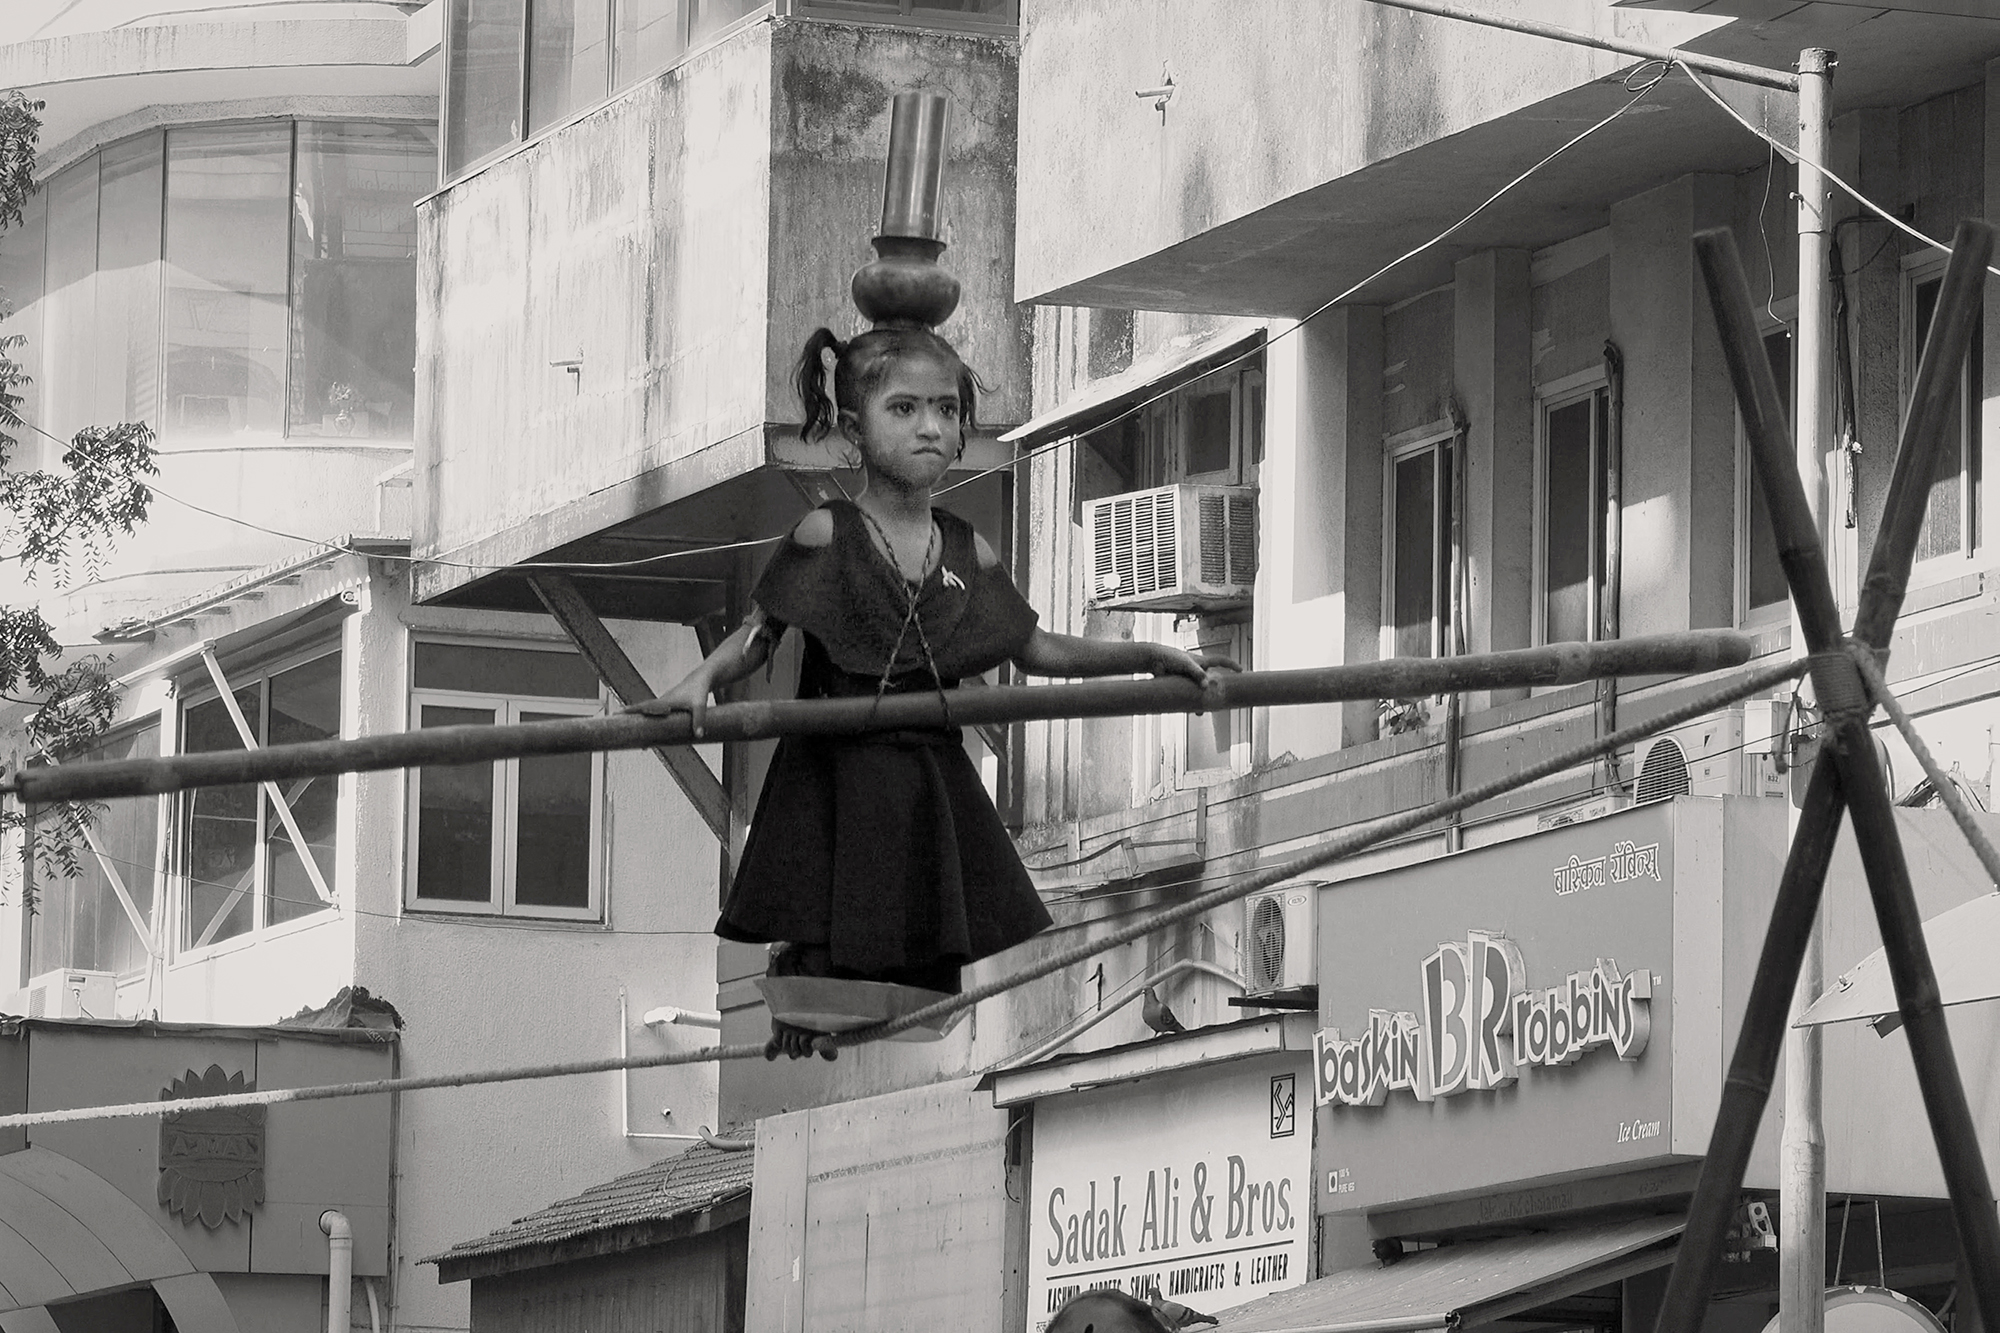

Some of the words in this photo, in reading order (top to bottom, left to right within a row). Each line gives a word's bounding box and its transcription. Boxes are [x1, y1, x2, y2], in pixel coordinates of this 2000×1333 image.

[1313, 1008, 1424, 1107] baskin
[1421, 930, 1514, 1096] BR
[1512, 958, 1642, 1066] robbins
[1617, 1122, 1631, 1143] Ice
[1632, 1119, 1660, 1140] Cream
[1047, 1175, 1127, 1267] Sadak
[1138, 1167, 1179, 1252] Ali
[1190, 1161, 1215, 1244] &
[1225, 1155, 1295, 1239] Bros.
[1169, 1263, 1225, 1296] HANDICRAFTS
[1234, 1260, 1241, 1287] &
[1250, 1253, 1289, 1285] LEATHER
